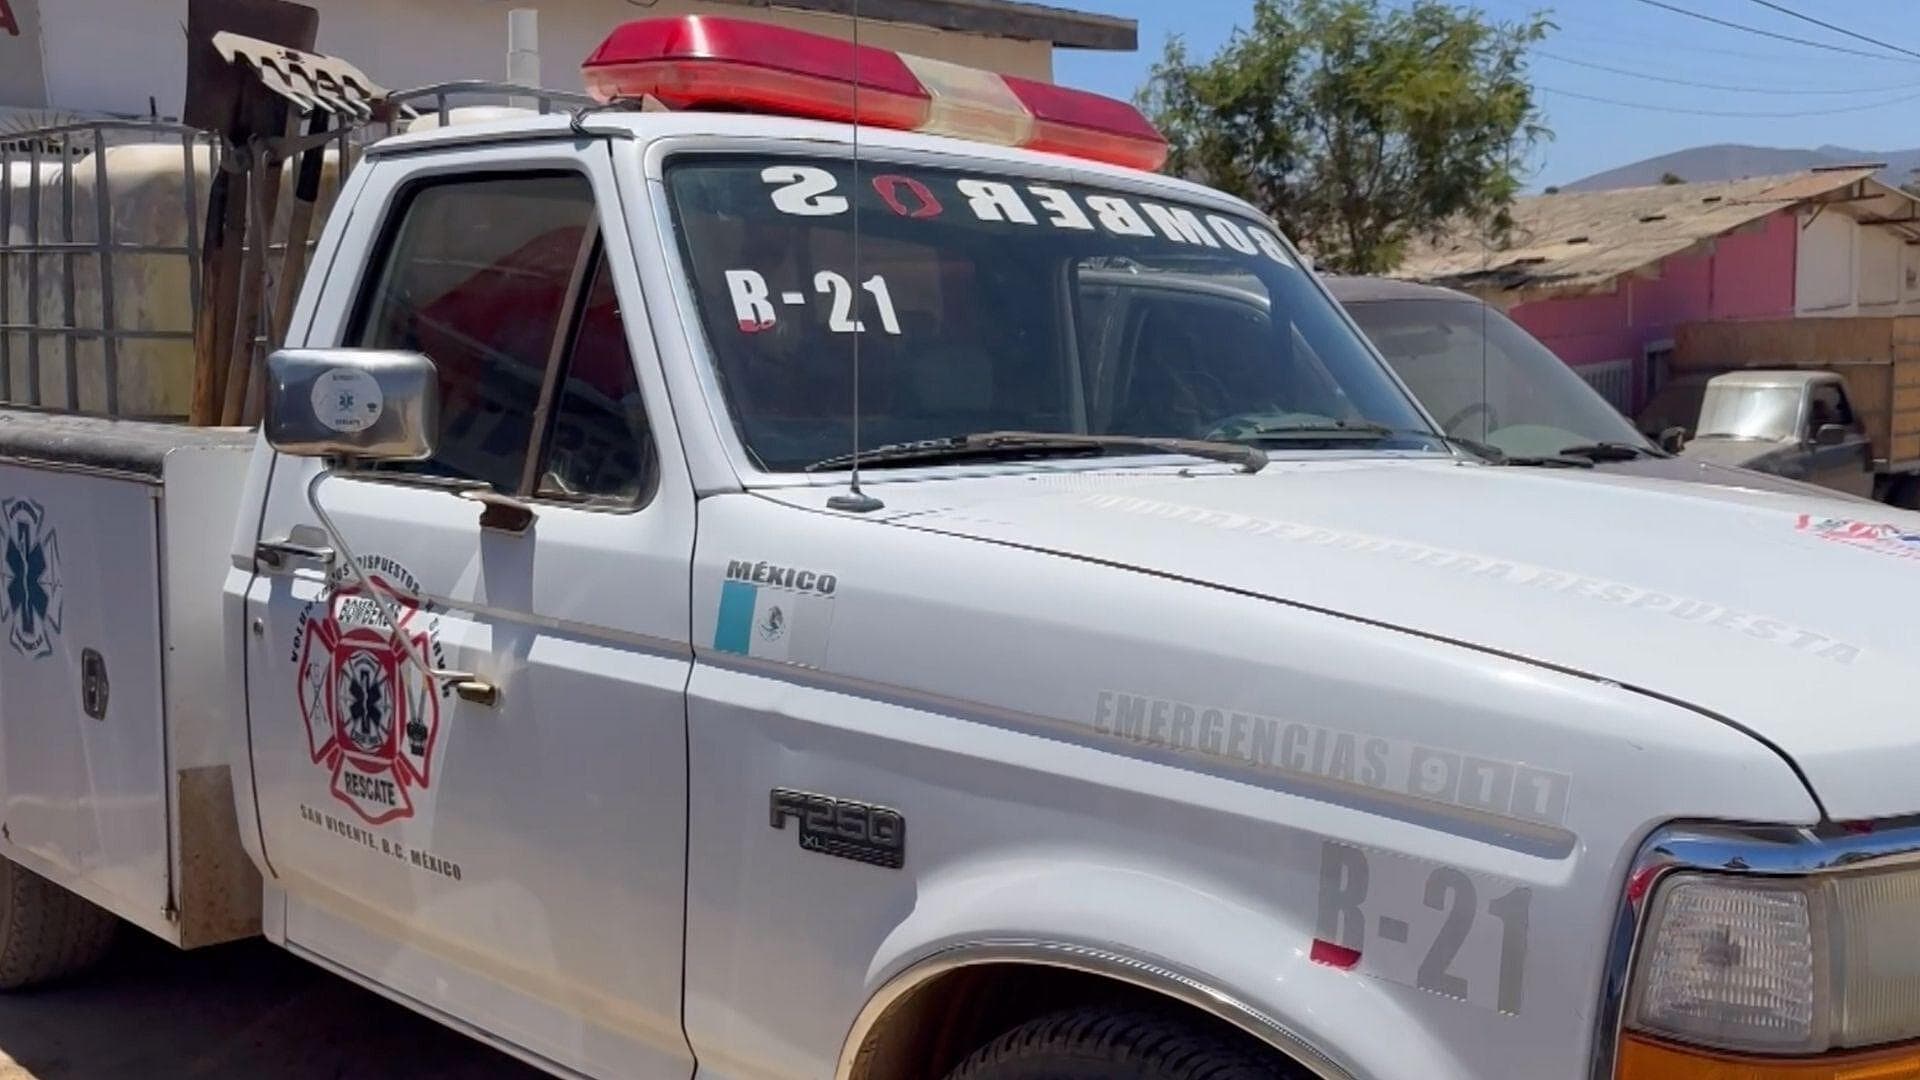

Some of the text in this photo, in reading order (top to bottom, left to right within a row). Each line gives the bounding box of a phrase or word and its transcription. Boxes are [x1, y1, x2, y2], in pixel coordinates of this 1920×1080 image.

[726, 559, 837, 595] MÉXICO
[1520, 569, 1863, 665] RESPUESTA
[1094, 690, 1566, 823] EMERGENCIAS 911
[344, 769, 397, 807] RESCATE
[300, 804, 323, 827] SAN
